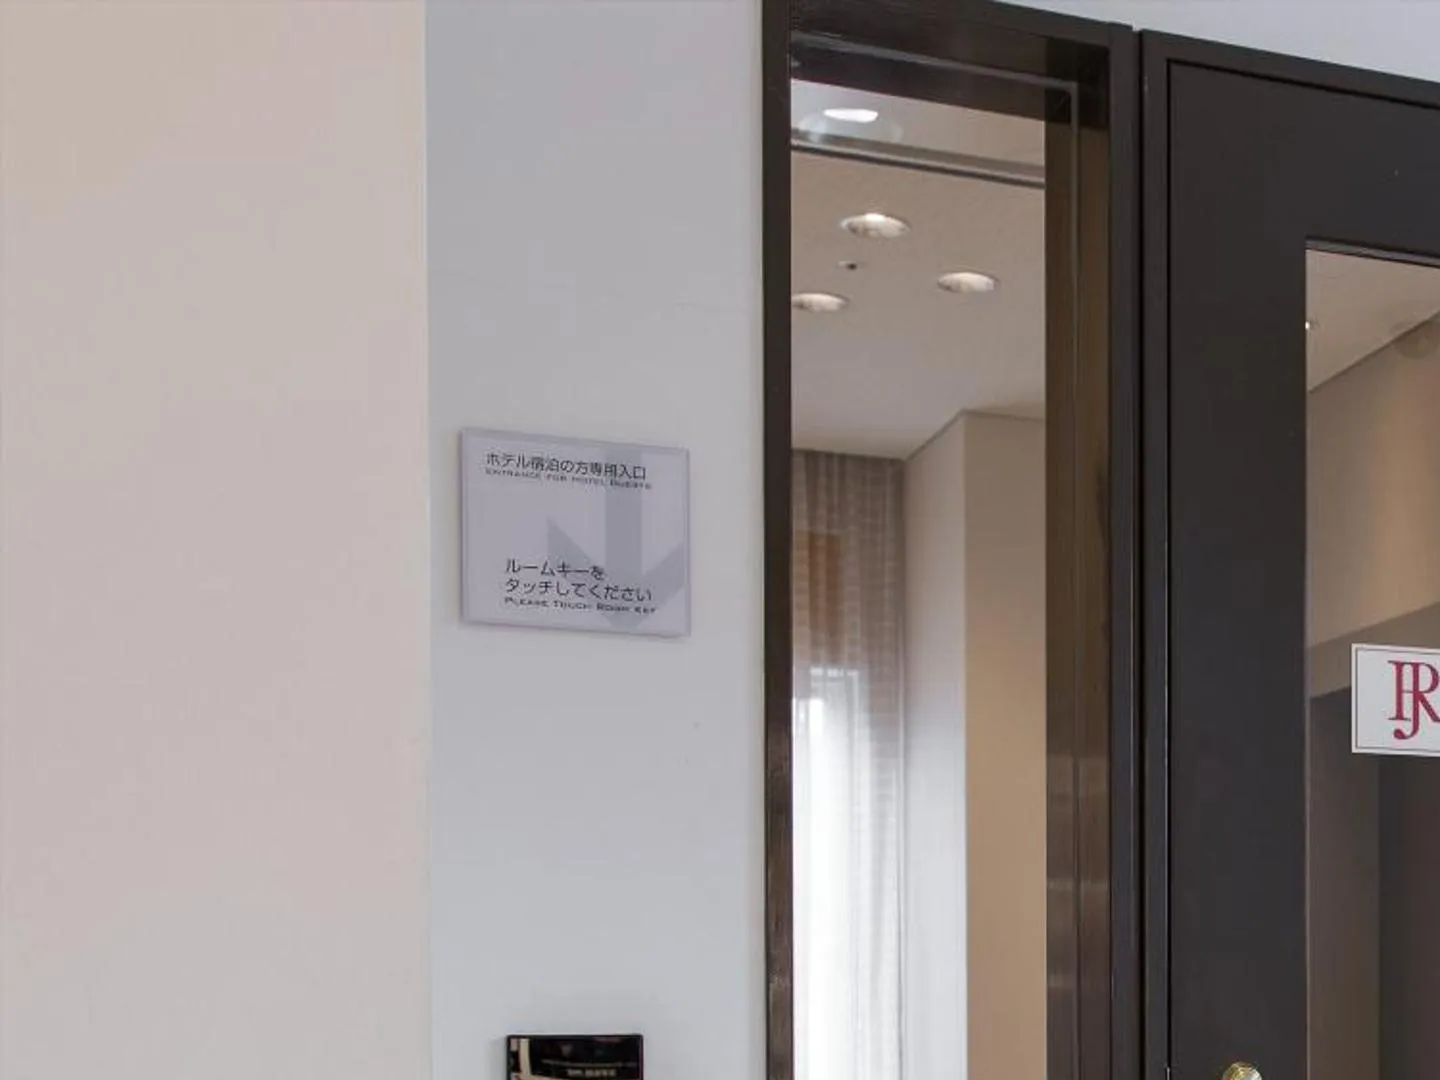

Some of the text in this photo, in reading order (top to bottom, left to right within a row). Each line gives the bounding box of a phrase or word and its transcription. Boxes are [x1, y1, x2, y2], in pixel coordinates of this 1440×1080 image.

[505, 558, 605, 581] ルームキーを
[505, 577, 652, 602] タッチしてください
